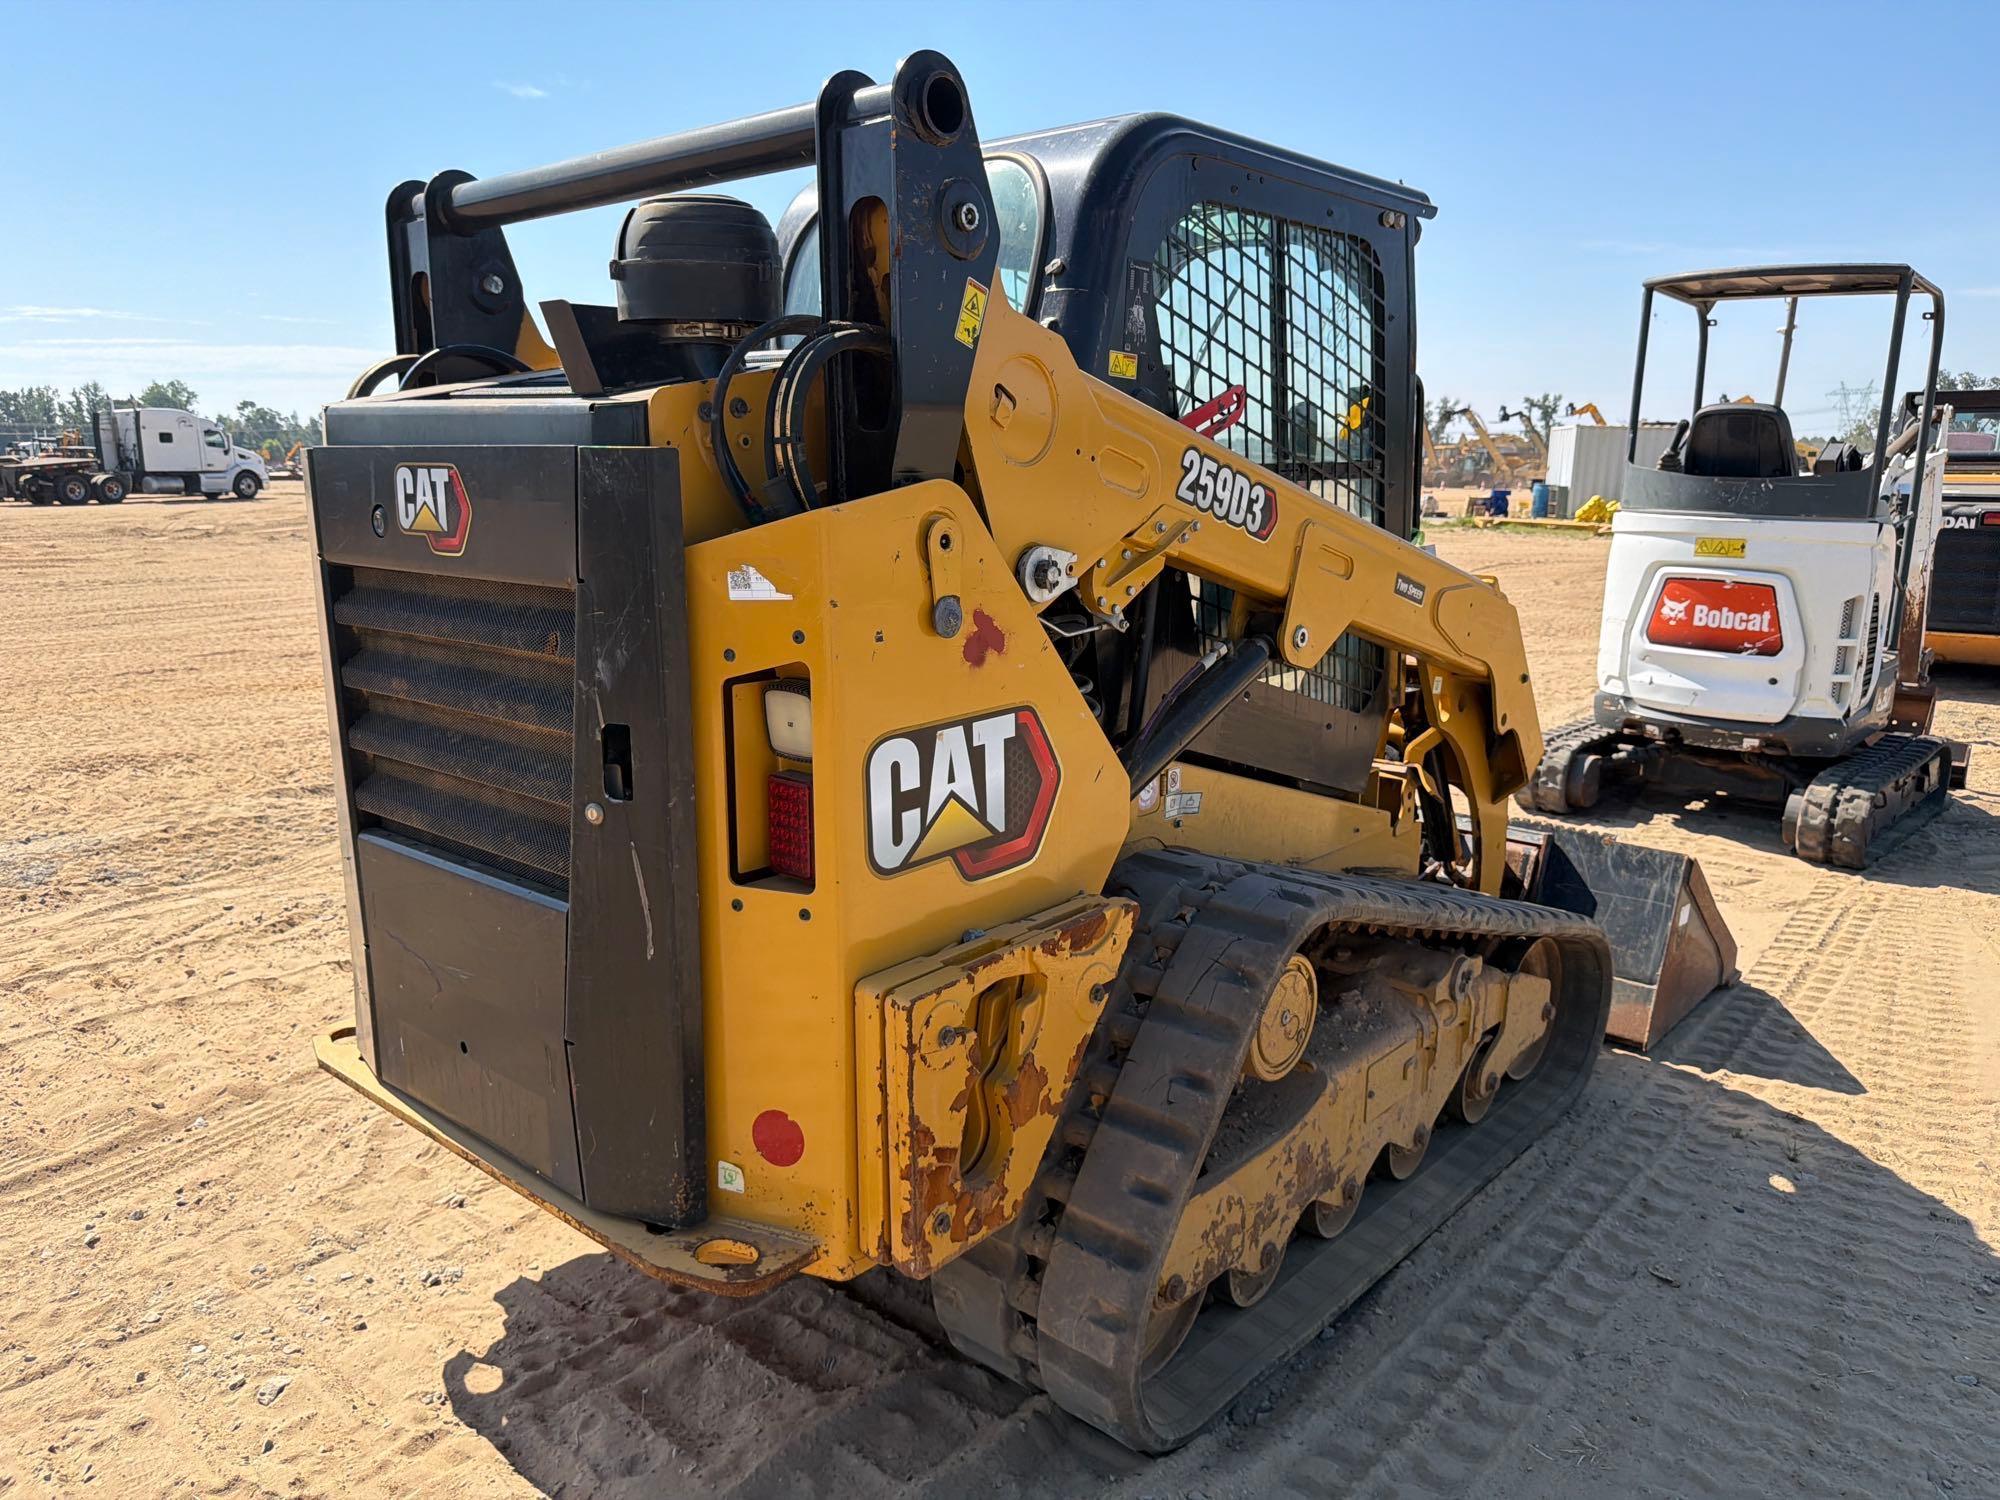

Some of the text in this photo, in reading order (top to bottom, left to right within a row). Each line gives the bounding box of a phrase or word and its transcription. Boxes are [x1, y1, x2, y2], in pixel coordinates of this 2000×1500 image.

[396, 466, 450, 532] CAT
[1177, 449, 1266, 533] 259D3
[1692, 604, 1771, 633] Bobcat
[869, 713, 1016, 869] CAT
